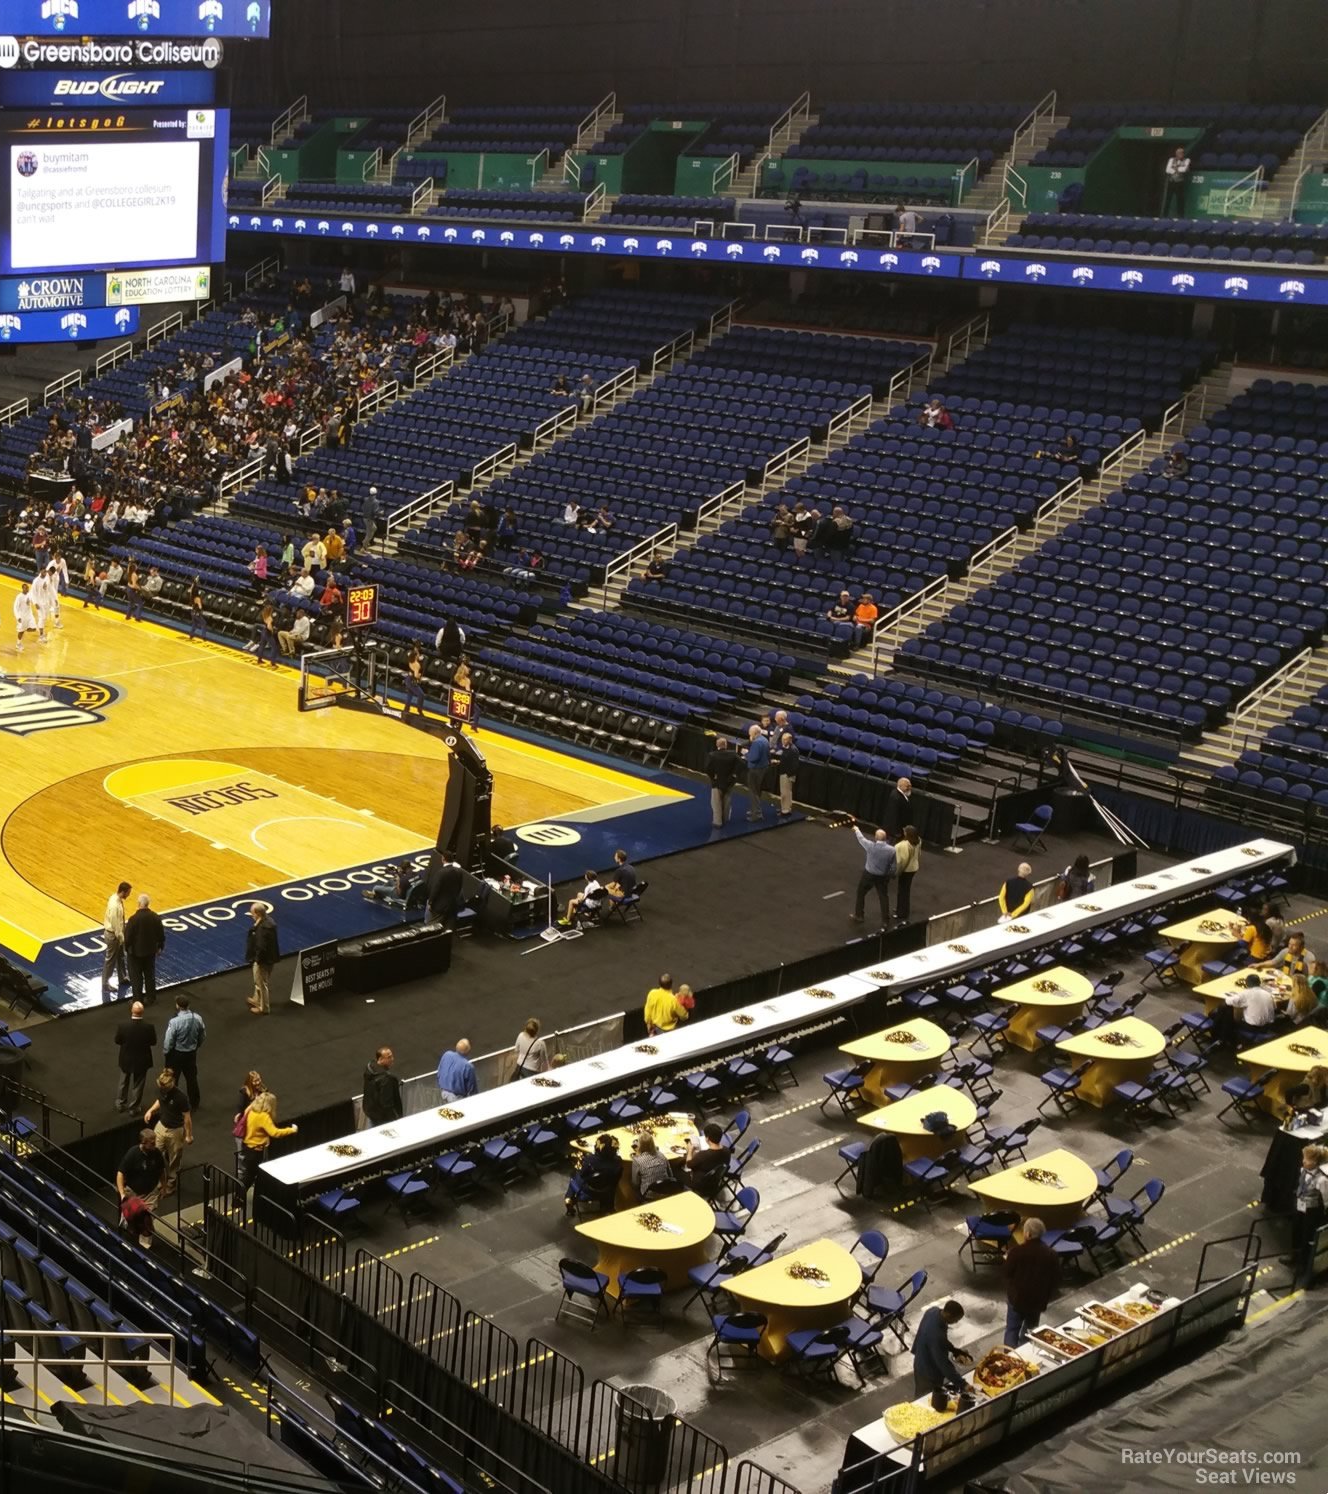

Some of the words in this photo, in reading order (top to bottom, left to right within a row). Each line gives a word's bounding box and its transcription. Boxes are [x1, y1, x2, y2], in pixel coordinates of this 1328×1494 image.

[23, 40, 133, 64] Greensboro
[138, 41, 218, 63] Coliseum
[53, 80, 99, 95] BUD
[106, 80, 165, 95] LIGHT
[153, 119, 174, 128] Presented
[175, 119, 186, 130] by:
[1049, 171, 1062, 180] 230
[85, 184, 133, 196] Greensboro
[17, 200, 73, 213] @uncgsports
[74, 200, 90, 209] and
[980, 260, 1001, 273] UNCG
[1025, 263, 1047, 276] UNCG
[1072, 267, 1094, 280] UNCG
[1121, 270, 1144, 283] UNCG
[1171, 273, 1195, 287] UNCG
[30, 277, 84, 296] CROWN
[125, 278, 152, 288] NORTH
[153, 275, 192, 286] CAROLINA
[1224, 277, 1249, 290] UNCG
[1279, 280, 1305, 294] UNCG
[125, 287, 163, 298] EDUCATION
[164, 285, 192, 295] LOTTERY
[18, 295, 84, 310] AUTOMOTIVE
[61, 312, 87, 330] UNCG
[349, 588, 374, 603] 22:03
[352, 601, 371, 622] 30
[452, 691, 471, 704] 22:03
[455, 702, 467, 715] 30
[162, 782, 279, 816] SOCON
[305, 973, 316, 984] BEST
[316, 968, 330, 981] SEATS
[309, 983, 318, 993] THE
